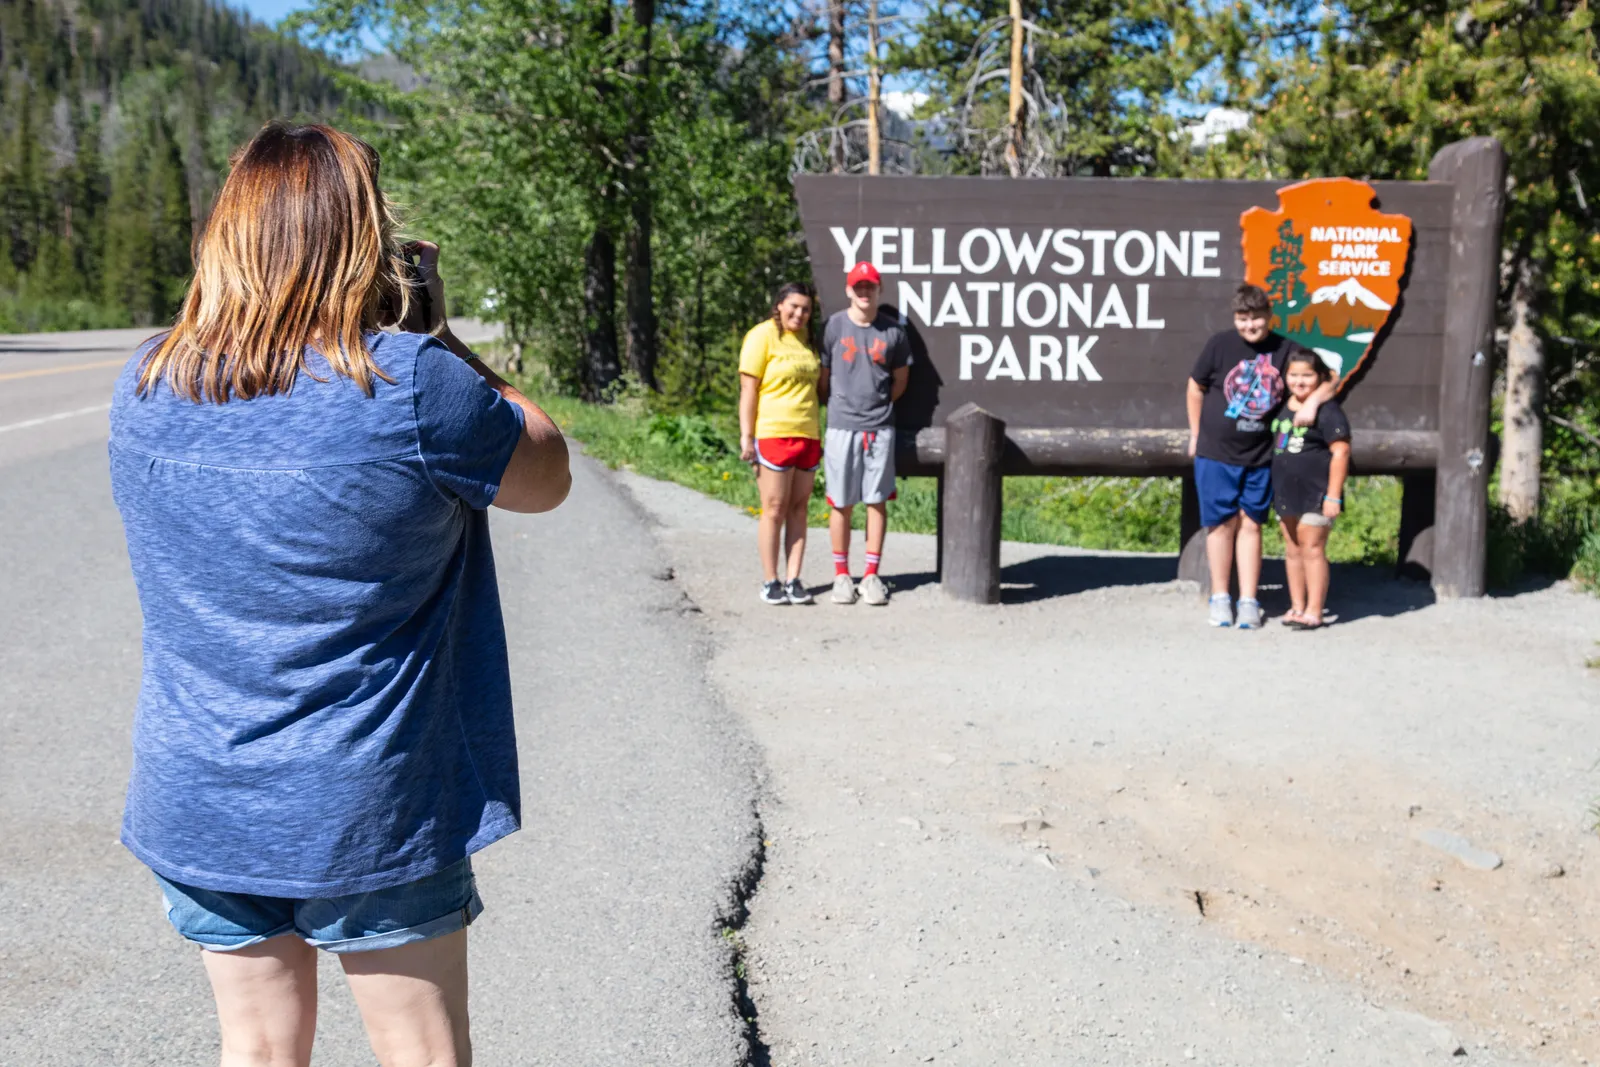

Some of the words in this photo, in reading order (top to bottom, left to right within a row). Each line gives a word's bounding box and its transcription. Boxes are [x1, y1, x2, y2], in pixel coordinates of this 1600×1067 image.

[1310, 226, 1402, 243] NATIONAL
[829, 226, 1221, 278] YELLOWSTONE
[1331, 243, 1379, 259] PARK
[1318, 260, 1391, 276] SERVICE
[897, 280, 1165, 330] NATIONAL
[958, 334, 1103, 382] PARK
